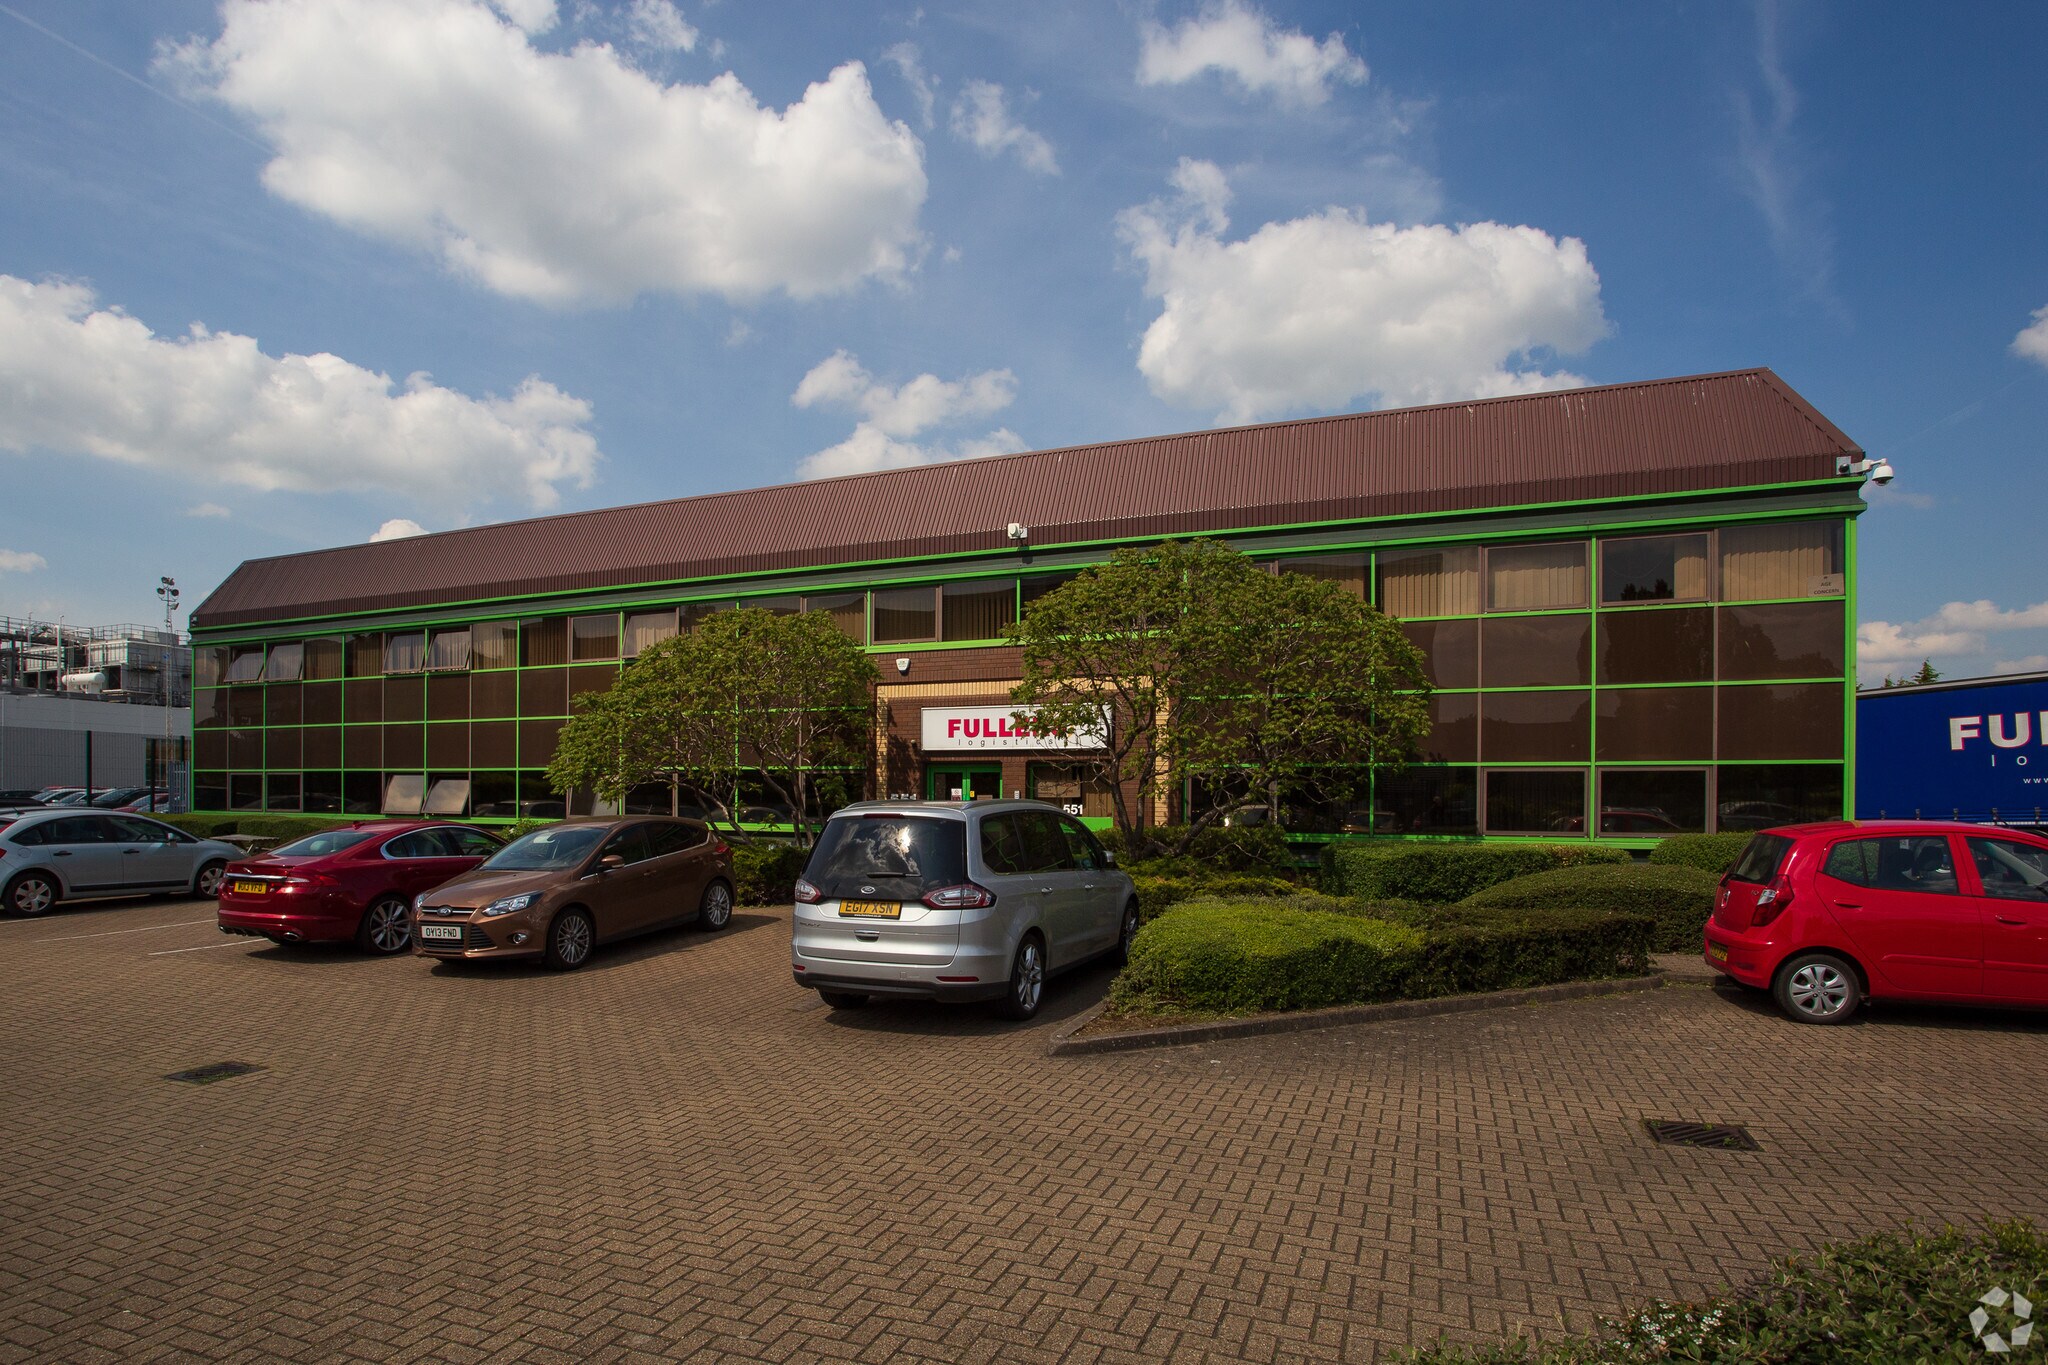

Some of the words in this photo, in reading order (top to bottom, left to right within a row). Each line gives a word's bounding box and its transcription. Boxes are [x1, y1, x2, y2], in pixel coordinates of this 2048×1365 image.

[958, 738, 1053, 747] logistics
[1063, 804, 1083, 815] 551
[845, 901, 869, 912] EG17
[872, 902, 893, 914] XSN
[425, 927, 441, 937] OY13
[443, 928, 457, 938] FND
